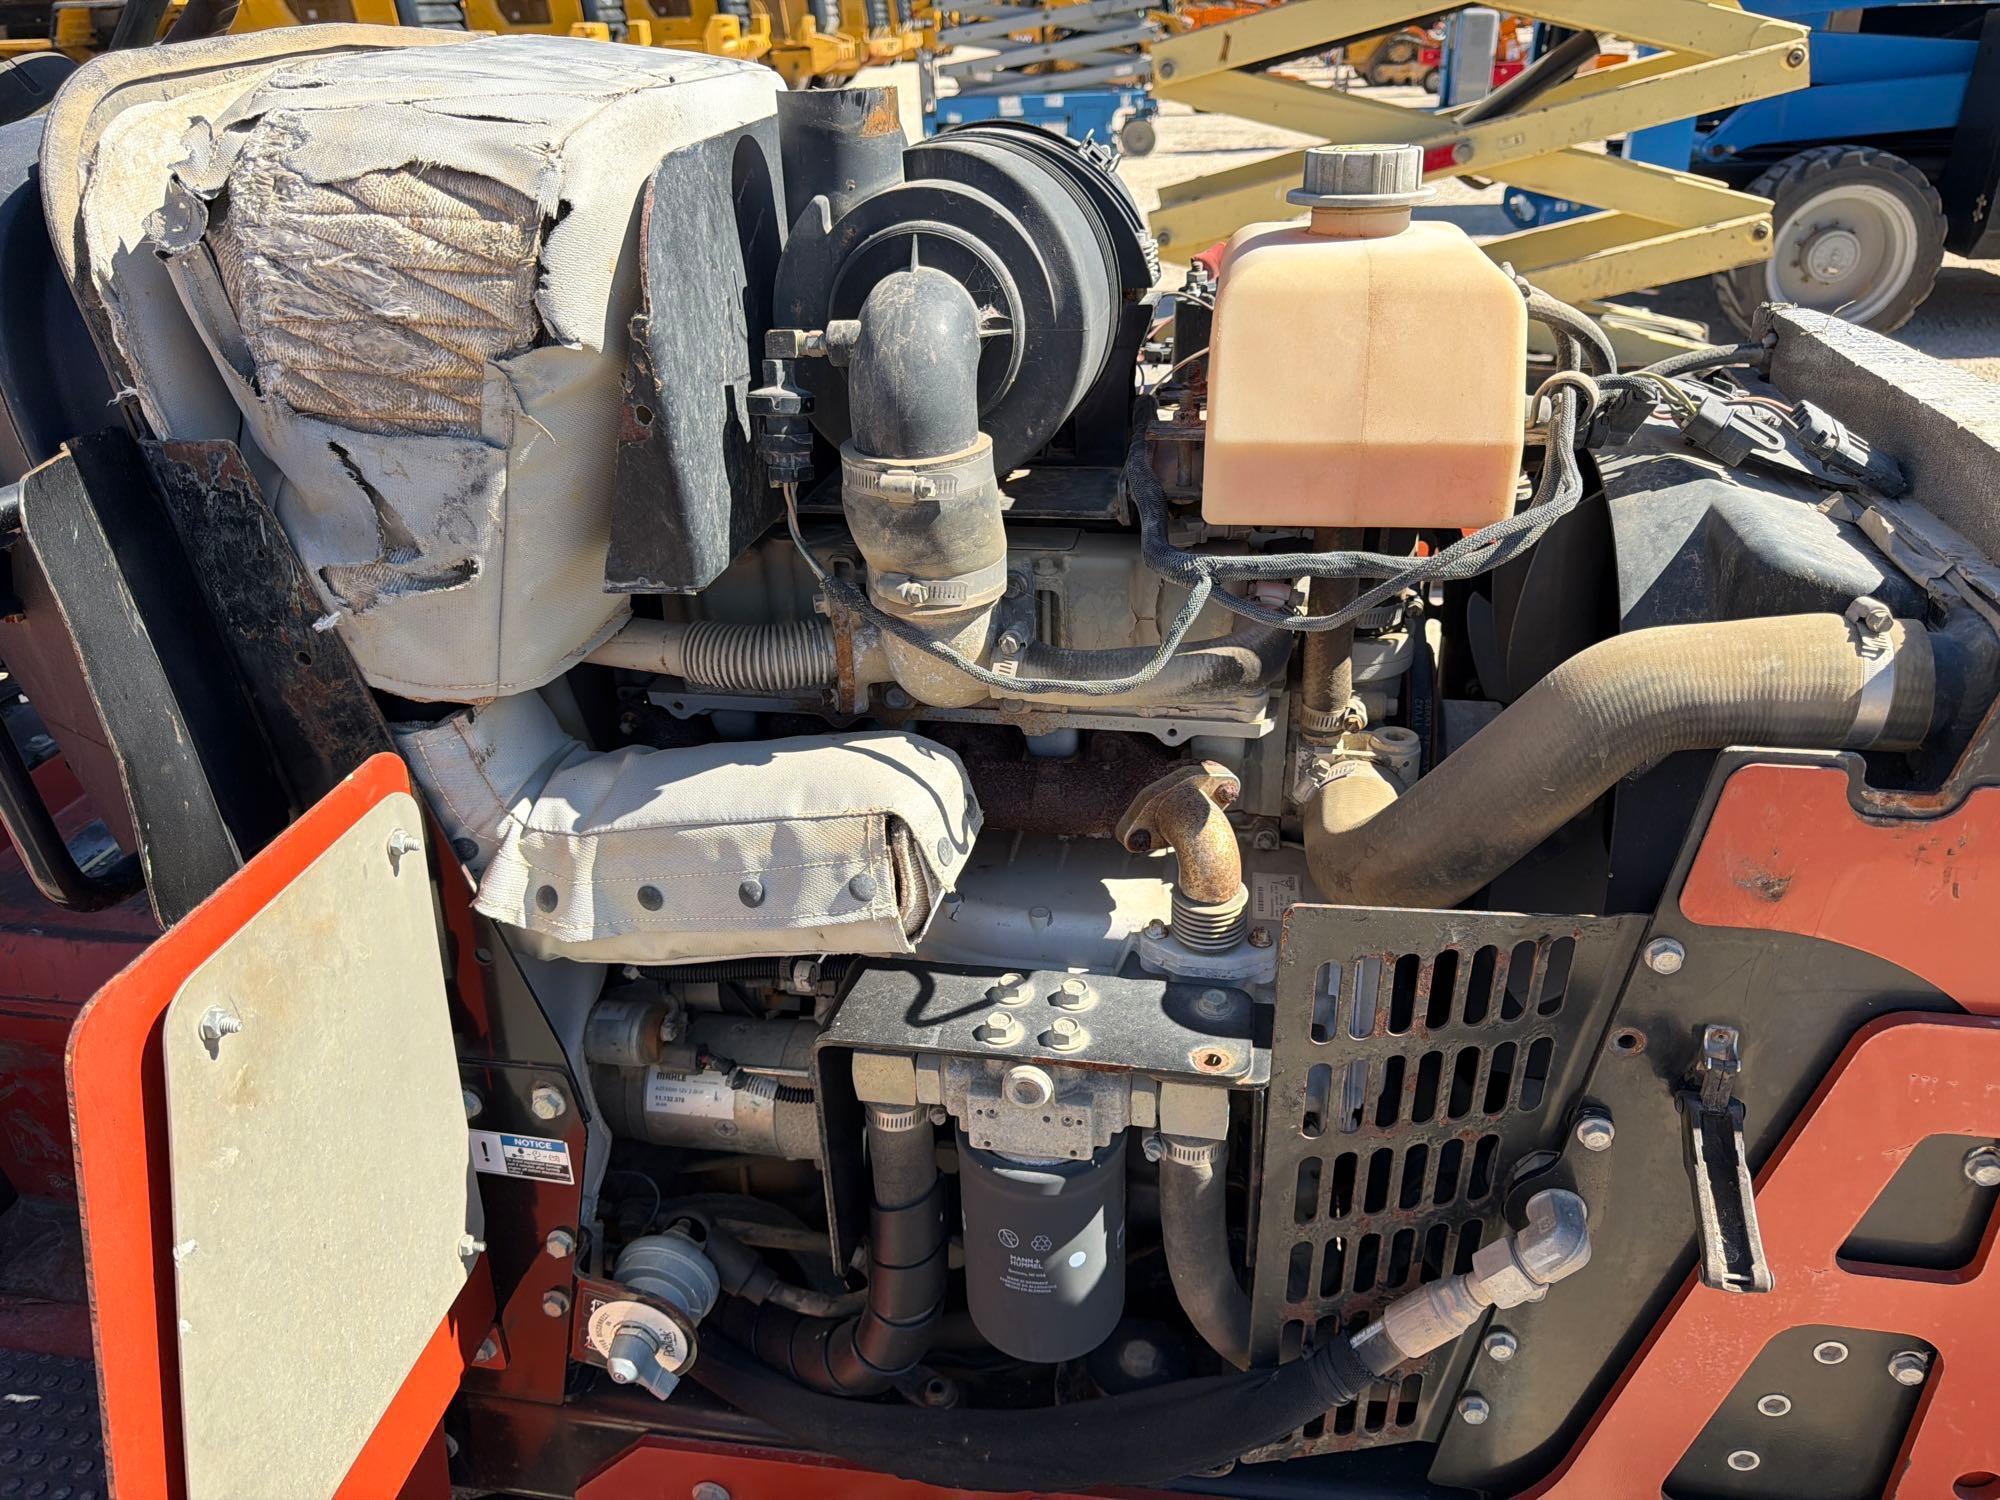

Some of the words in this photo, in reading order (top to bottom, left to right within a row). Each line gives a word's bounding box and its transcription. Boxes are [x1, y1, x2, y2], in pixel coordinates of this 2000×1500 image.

[656, 1072, 687, 1082] MAHLE
[514, 1138, 553, 1150] NOTICE
[1010, 1260, 1044, 1269] HUMMEL
